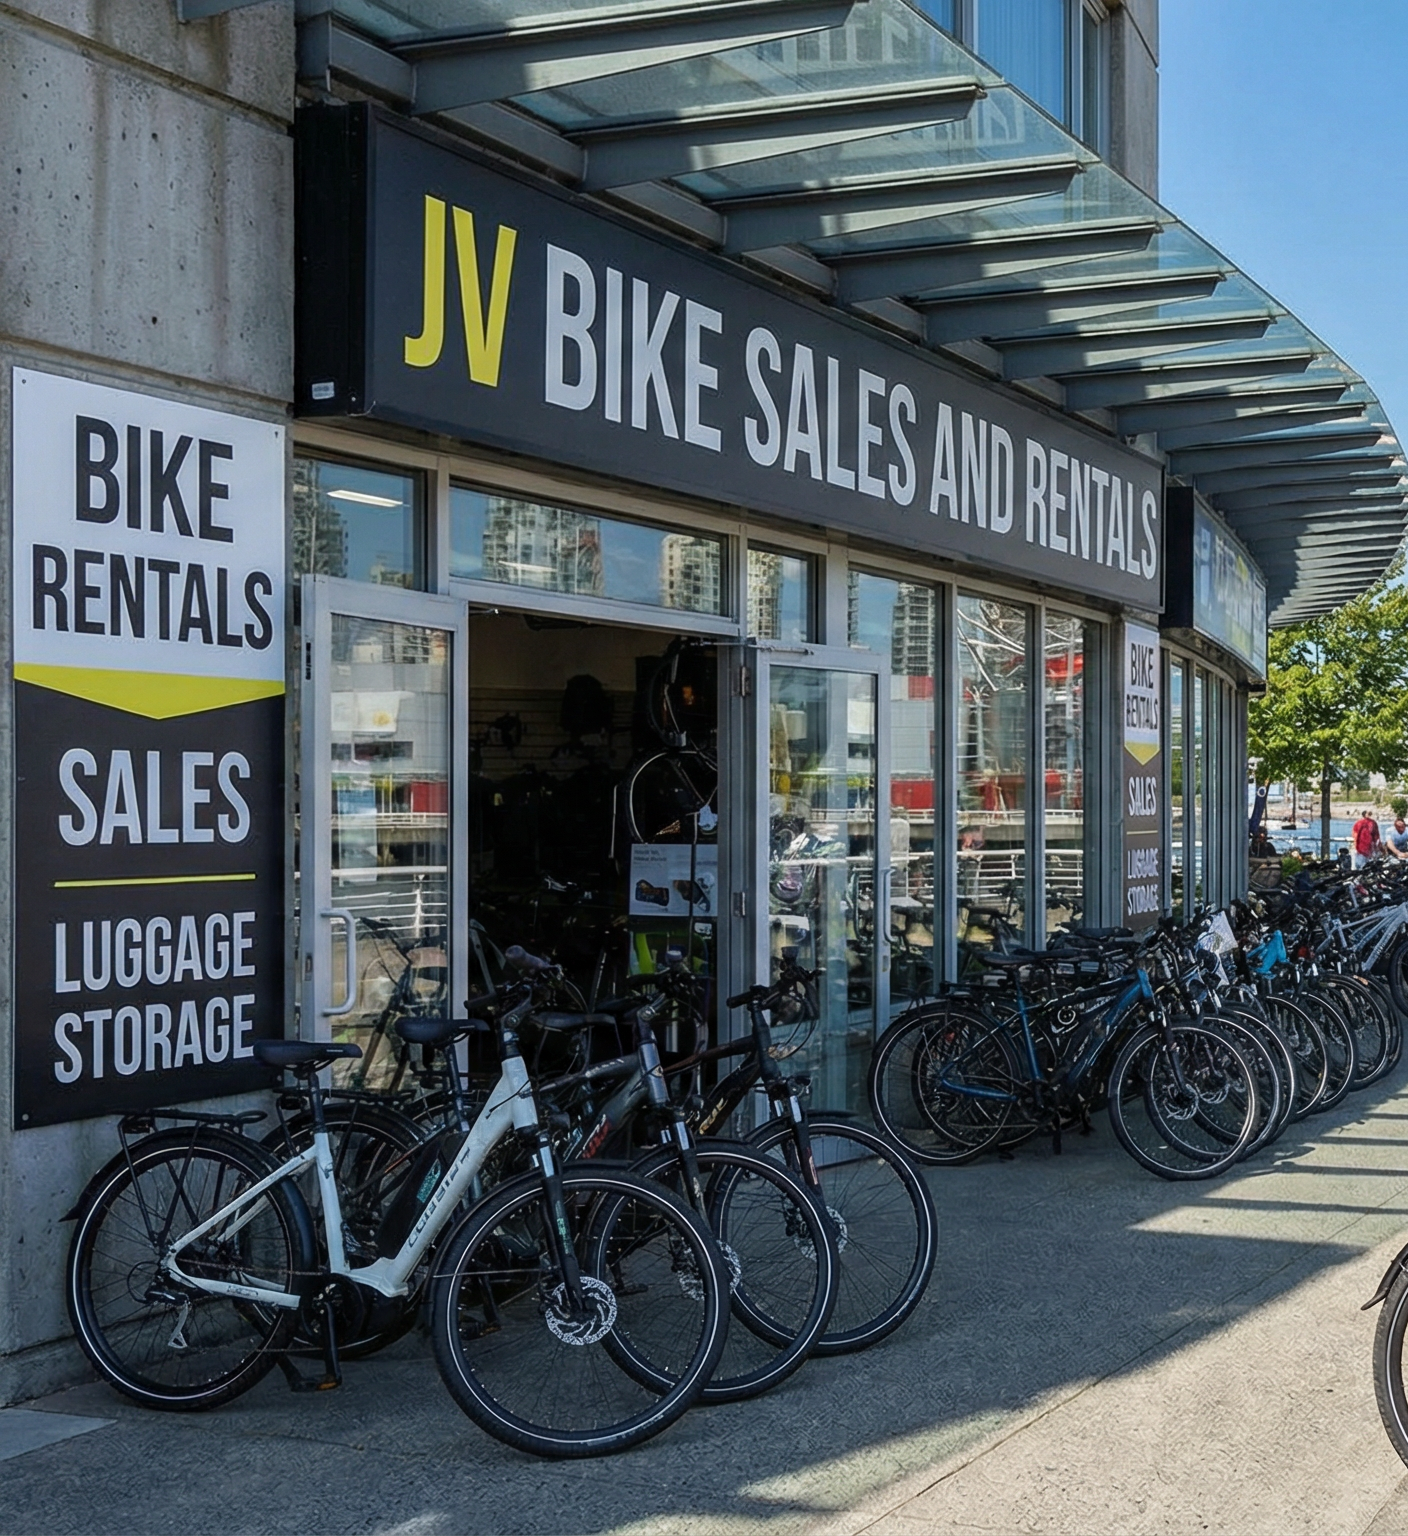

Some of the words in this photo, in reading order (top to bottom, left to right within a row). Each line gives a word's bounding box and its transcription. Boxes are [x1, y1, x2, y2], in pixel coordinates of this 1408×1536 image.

[404, 194, 517, 388] JV
[545, 242, 723, 453] BIKE
[744, 327, 917, 506] SALES
[930, 401, 1014, 535] AND
[1025, 437, 1157, 580] RENTALS
[75, 415, 234, 543] BIKE
[32, 544, 273, 650] RENTALS
[1131, 643, 1154, 689] BIKE
[1126, 694, 1158, 730] RENTALS
[58, 748, 250, 846] SALES
[1128, 776, 1157, 817] SALES
[55, 911, 256, 993] LUGGAGE
[54, 994, 255, 1083] STORAGE
